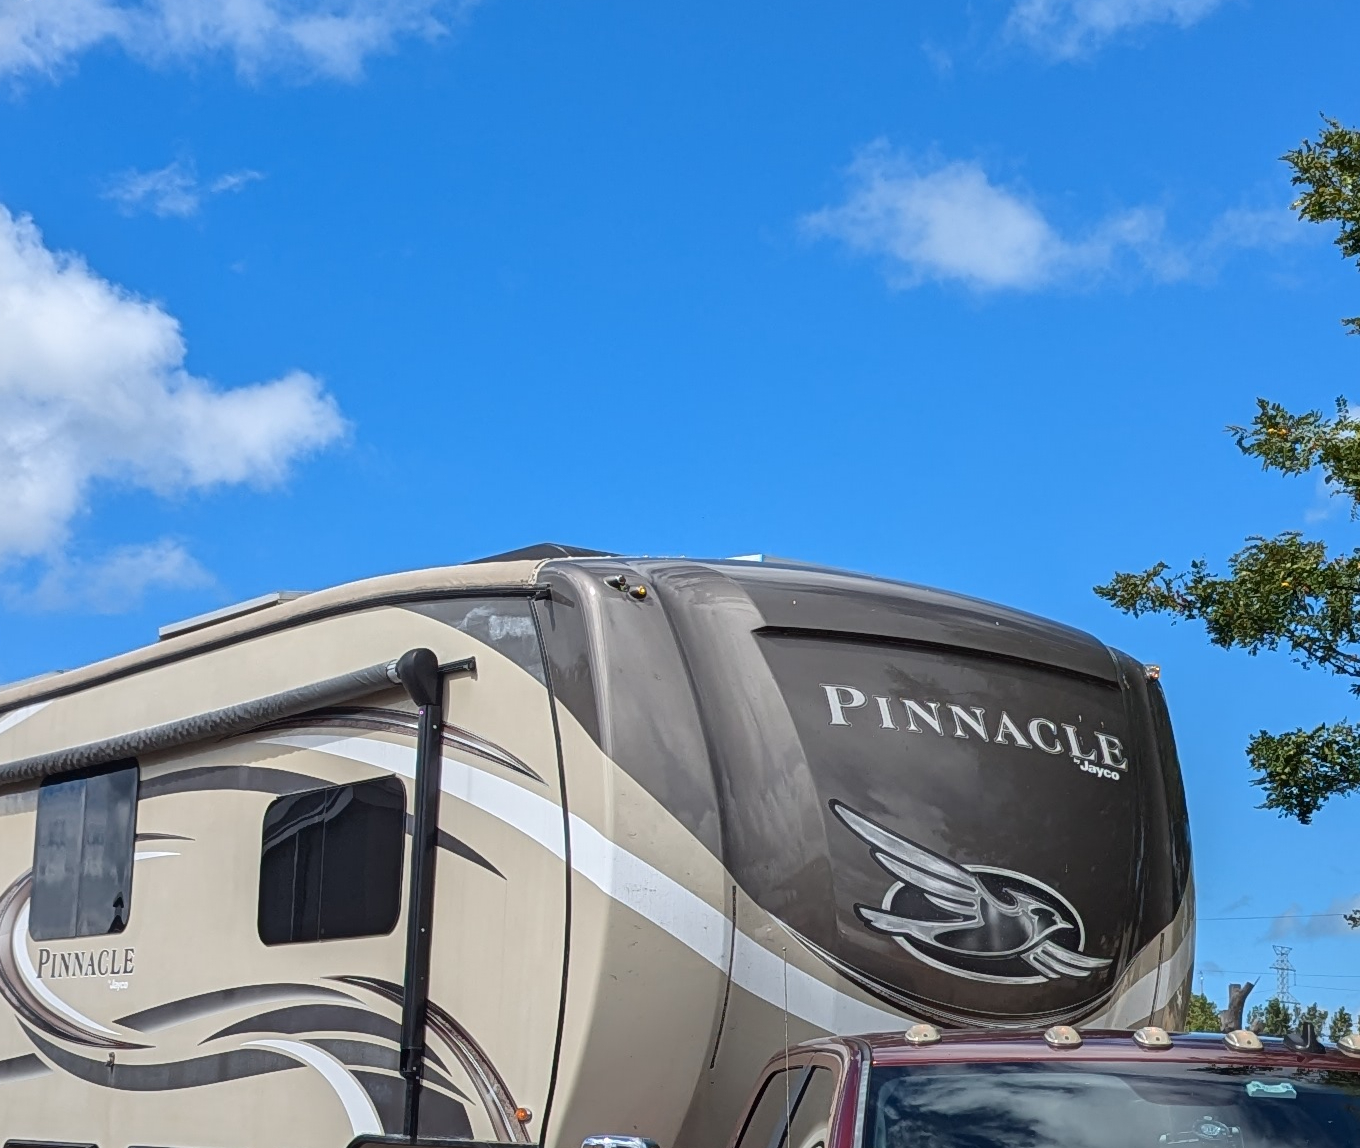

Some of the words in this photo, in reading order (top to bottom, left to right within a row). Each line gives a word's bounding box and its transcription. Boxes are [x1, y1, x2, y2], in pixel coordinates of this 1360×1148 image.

[820, 683, 1128, 772] PINNACLE
[1080, 760, 1120, 781] Jayco
[36, 947, 135, 979] PINNACLE
